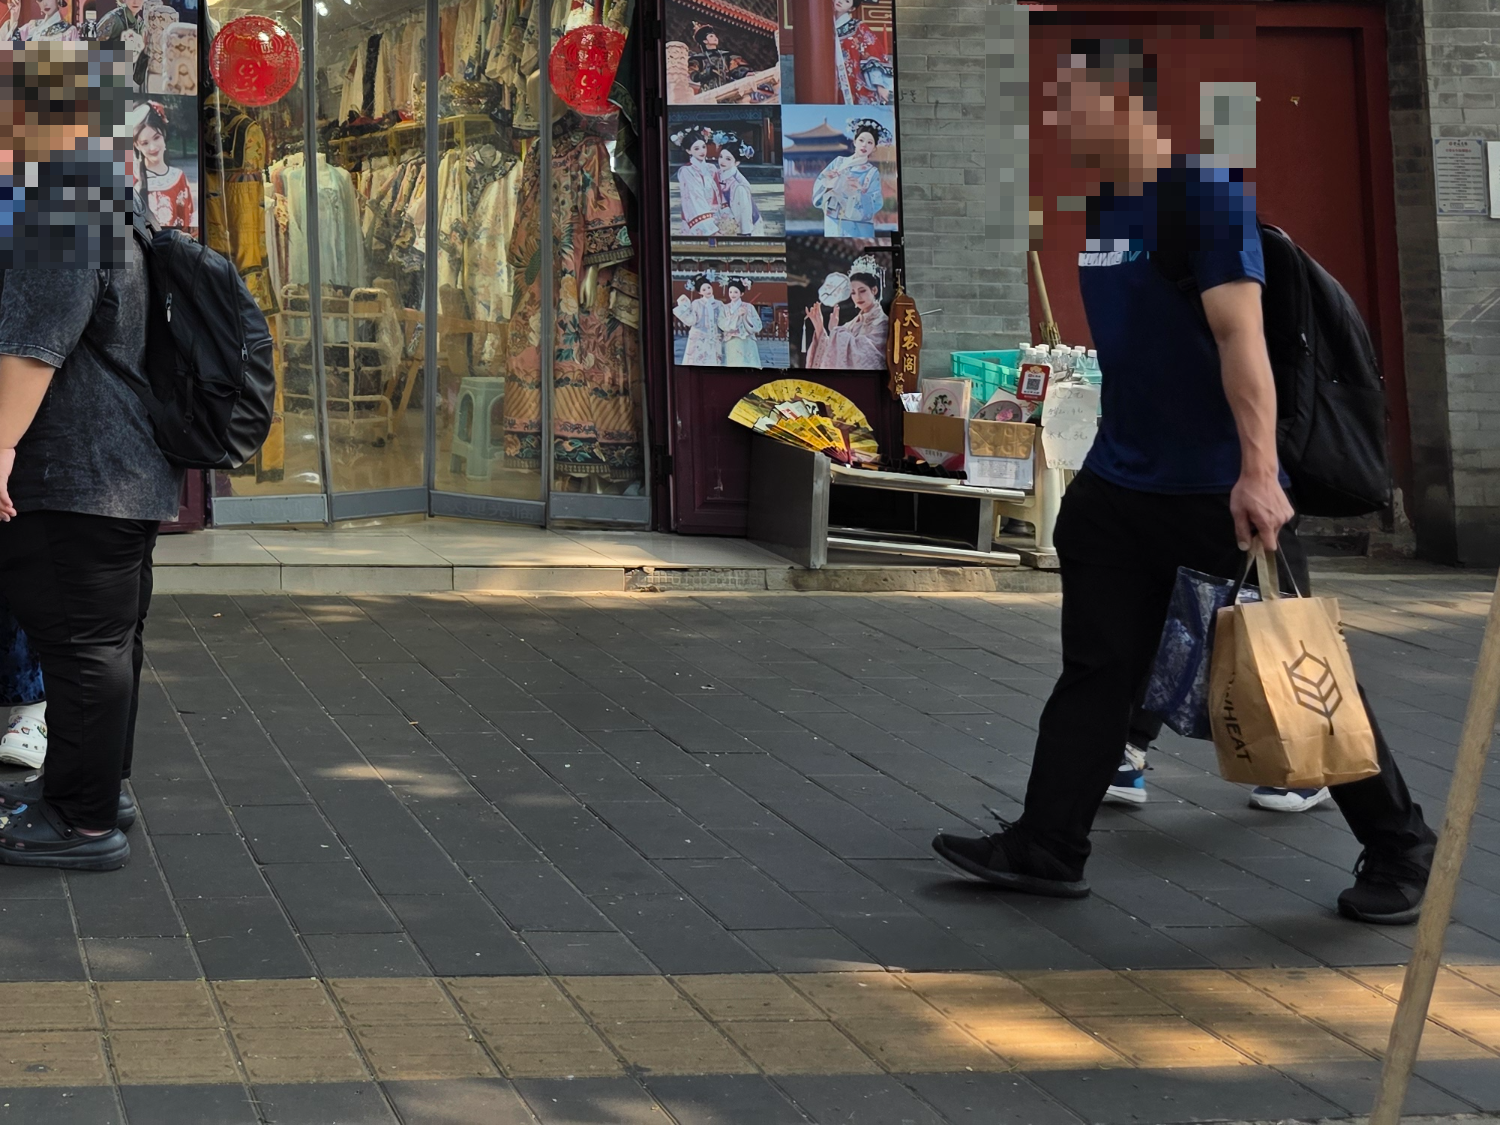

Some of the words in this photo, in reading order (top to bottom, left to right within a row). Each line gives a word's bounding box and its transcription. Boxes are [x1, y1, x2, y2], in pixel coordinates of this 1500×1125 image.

[902, 309, 919, 374] 天衣阁
[441, 498, 534, 520] 欢迎光临
